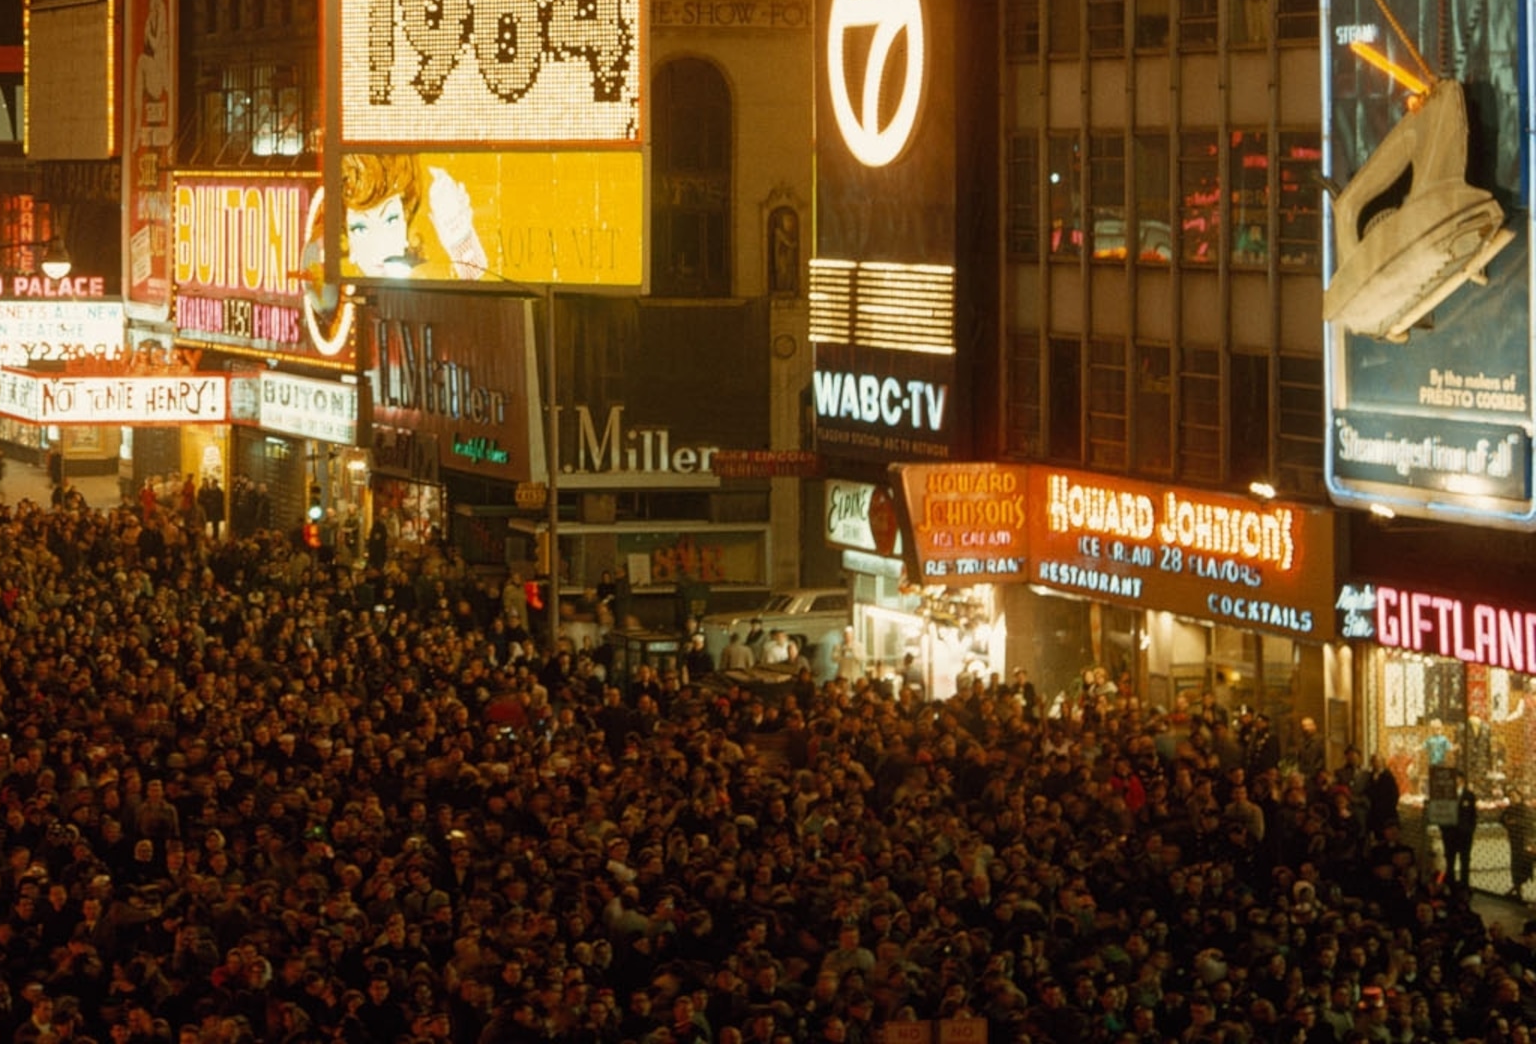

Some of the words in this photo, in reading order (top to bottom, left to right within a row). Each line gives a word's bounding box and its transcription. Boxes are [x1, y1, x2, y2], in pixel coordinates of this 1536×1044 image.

[14, 276, 105, 298] PALACE
[87, 306, 119, 319] NEW
[146, 380, 217, 416] HENRY!
[1419, 386, 1474, 409] PRESTO
[926, 471, 1016, 495] HOWARD
[1047, 474, 1155, 541] HOWARD
[1160, 491, 1295, 572] JOHNSON'S
[1160, 544, 1184, 573] 28
[1038, 561, 1144, 599] RESTAURANT
[1207, 592, 1314, 633] COCKTAILS
